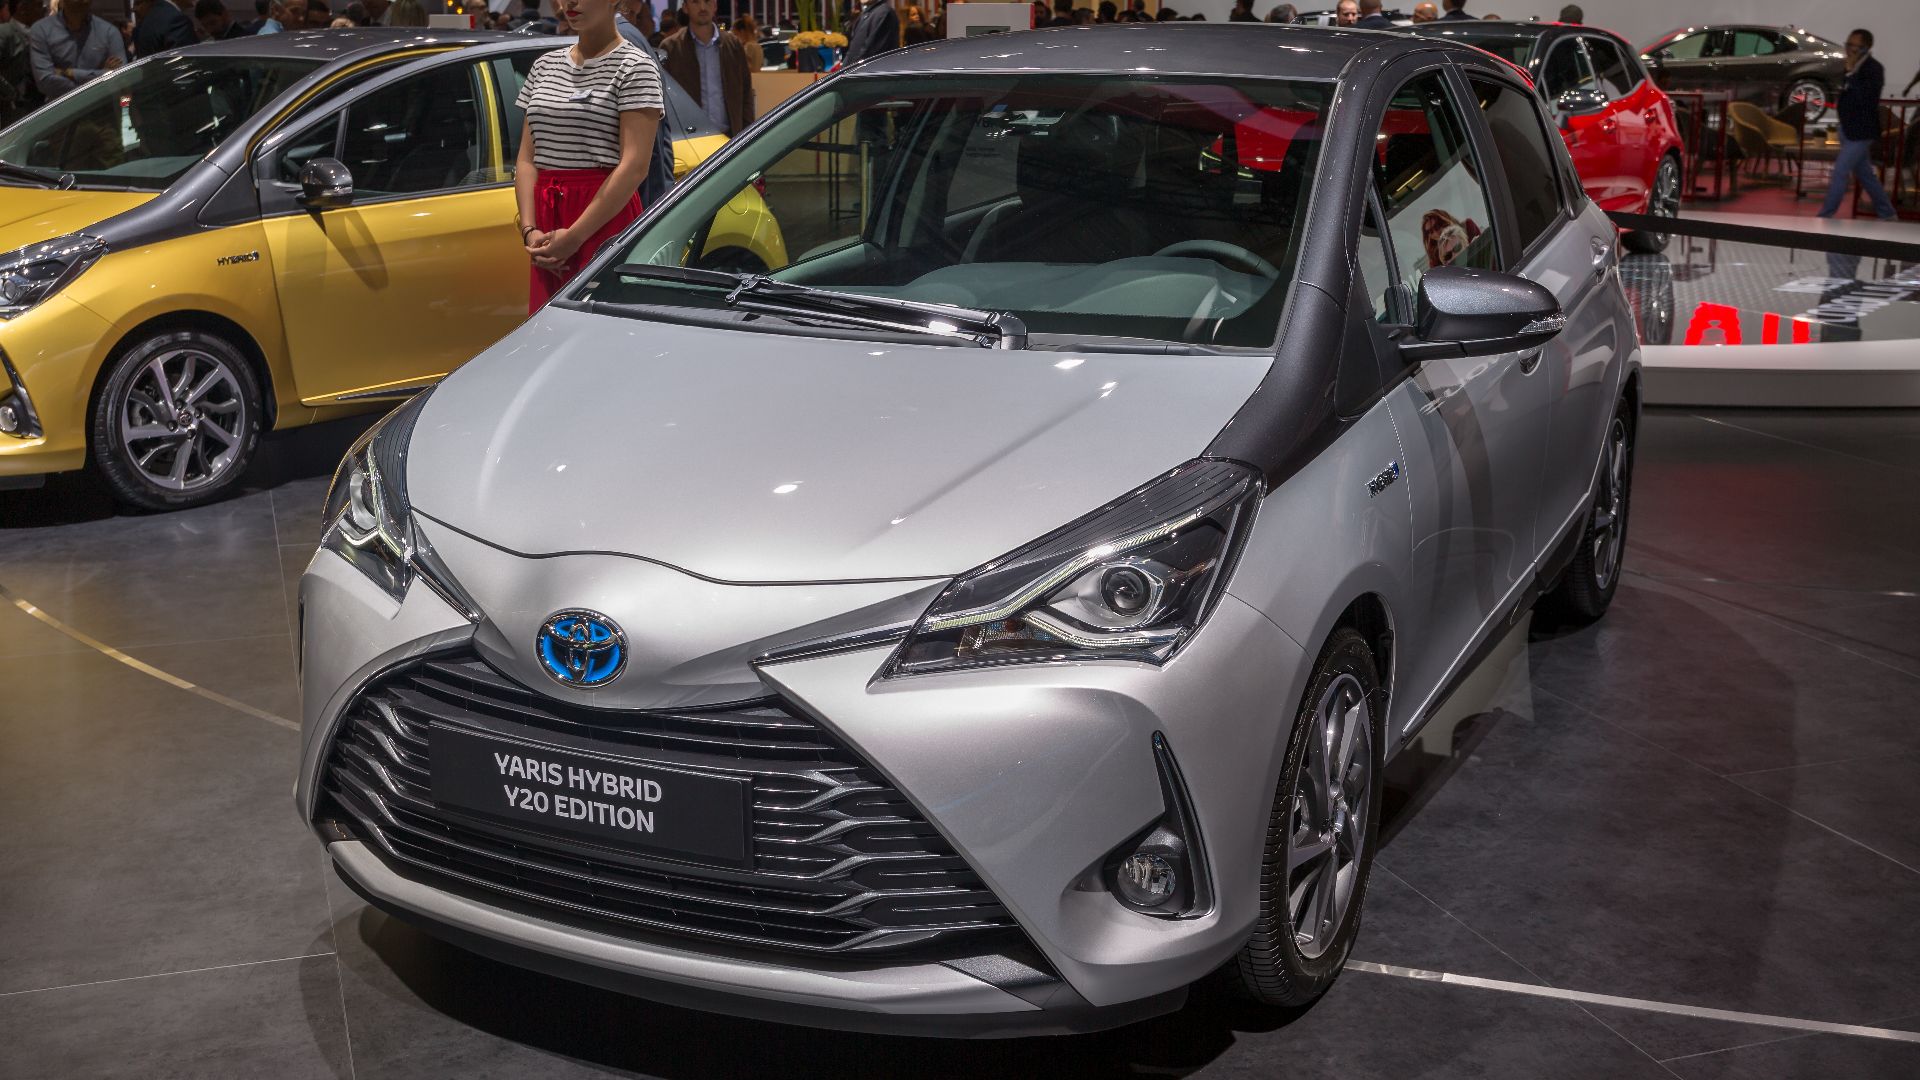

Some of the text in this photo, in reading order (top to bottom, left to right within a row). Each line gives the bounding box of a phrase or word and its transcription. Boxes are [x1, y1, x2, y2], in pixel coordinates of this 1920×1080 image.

[494, 752, 662, 803] YARIS HYBRID
[504, 784, 654, 834] Y20 EDITION
